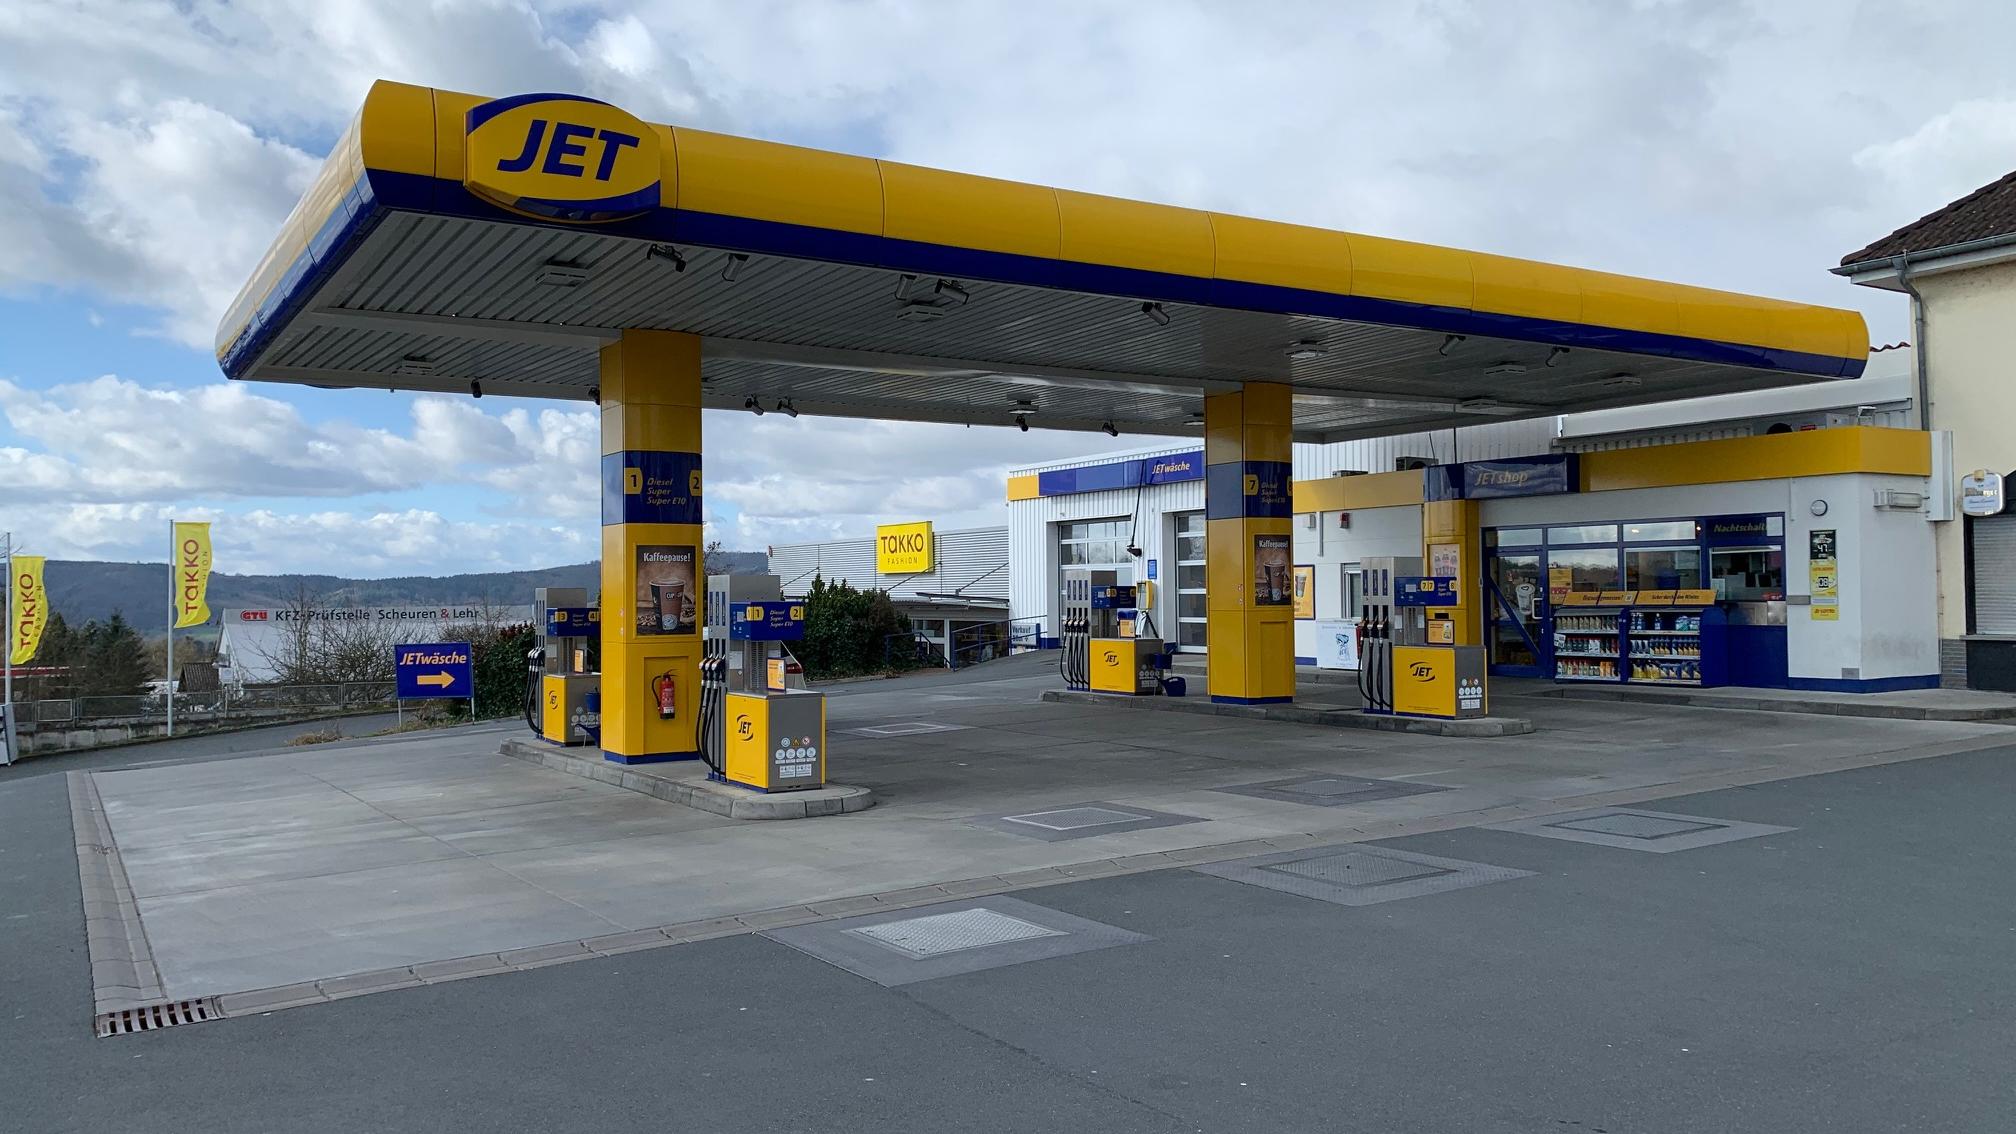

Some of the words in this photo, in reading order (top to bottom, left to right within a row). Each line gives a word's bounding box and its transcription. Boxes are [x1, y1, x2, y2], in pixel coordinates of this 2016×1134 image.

[497, 119, 640, 182] JET
[630, 474, 637, 488] 1
[647, 477, 673, 486] Diesel
[692, 477, 700, 490] 2
[1249, 480, 1256, 490] 7
[647, 487, 672, 496] Super
[647, 496, 671, 506] Super
[672, 497, 687, 505] E10
[643, 552, 691, 564] Kaffeepause!
[887, 556, 918, 565] FASHION
[275, 608, 370, 621] KFZ-Prüfstelle
[378, 608, 437, 619] Scheuren
[440, 608, 449, 618] &
[453, 608, 479, 618] Lehr
[399, 651, 467, 666] JETwäsche
[1105, 654, 1118, 663] JET
[1412, 667, 1432, 677] JET
[738, 721, 752, 735] JET
